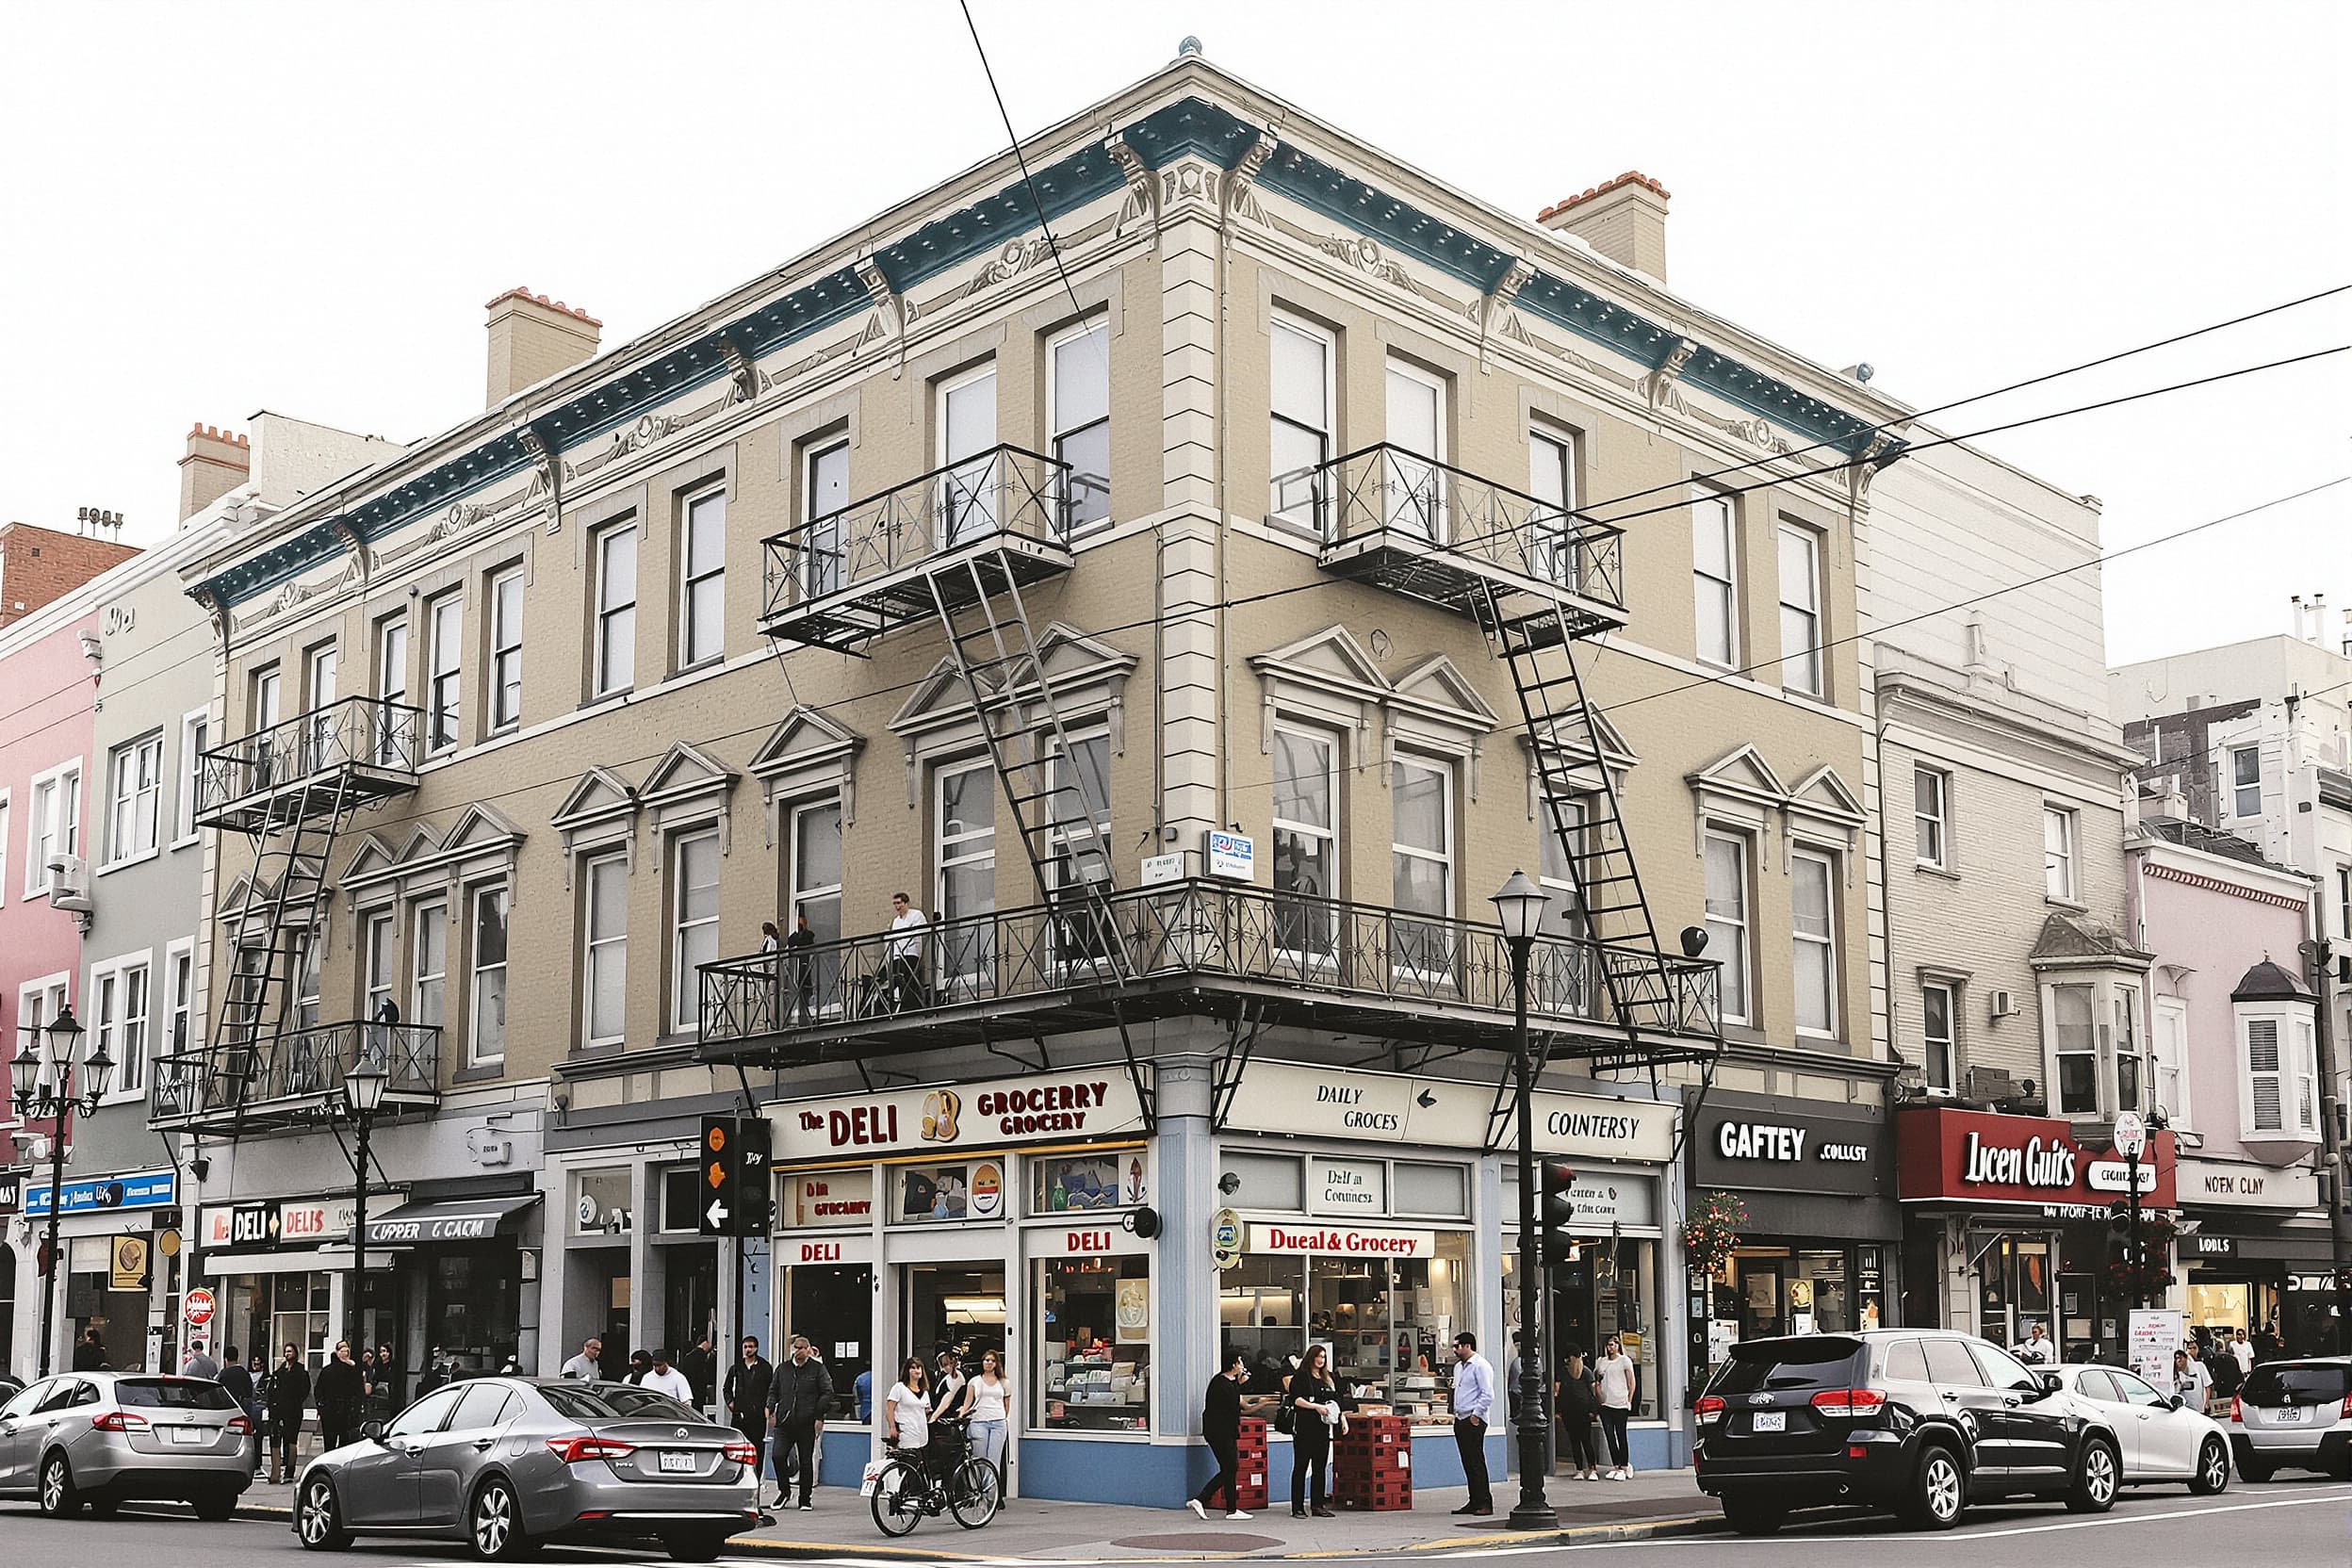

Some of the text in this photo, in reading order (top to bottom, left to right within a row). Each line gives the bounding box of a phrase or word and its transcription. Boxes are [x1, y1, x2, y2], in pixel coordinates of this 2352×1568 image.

[977, 1082, 1108, 1116] GROCERRY
[1316, 1085, 1364, 1104] DAILY
[829, 1104, 898, 1146] DELI
[1000, 1112, 1086, 1135] GROCERY
[1344, 1110, 1398, 1131] GROCES
[1720, 1121, 1806, 1161] GAFTEY
[235, 1210, 267, 1241] DELI
[801, 1243, 841, 1262] DELI
[1067, 1232, 1111, 1251] DELI
[1269, 1228, 1418, 1256] Dueal & Grocery
